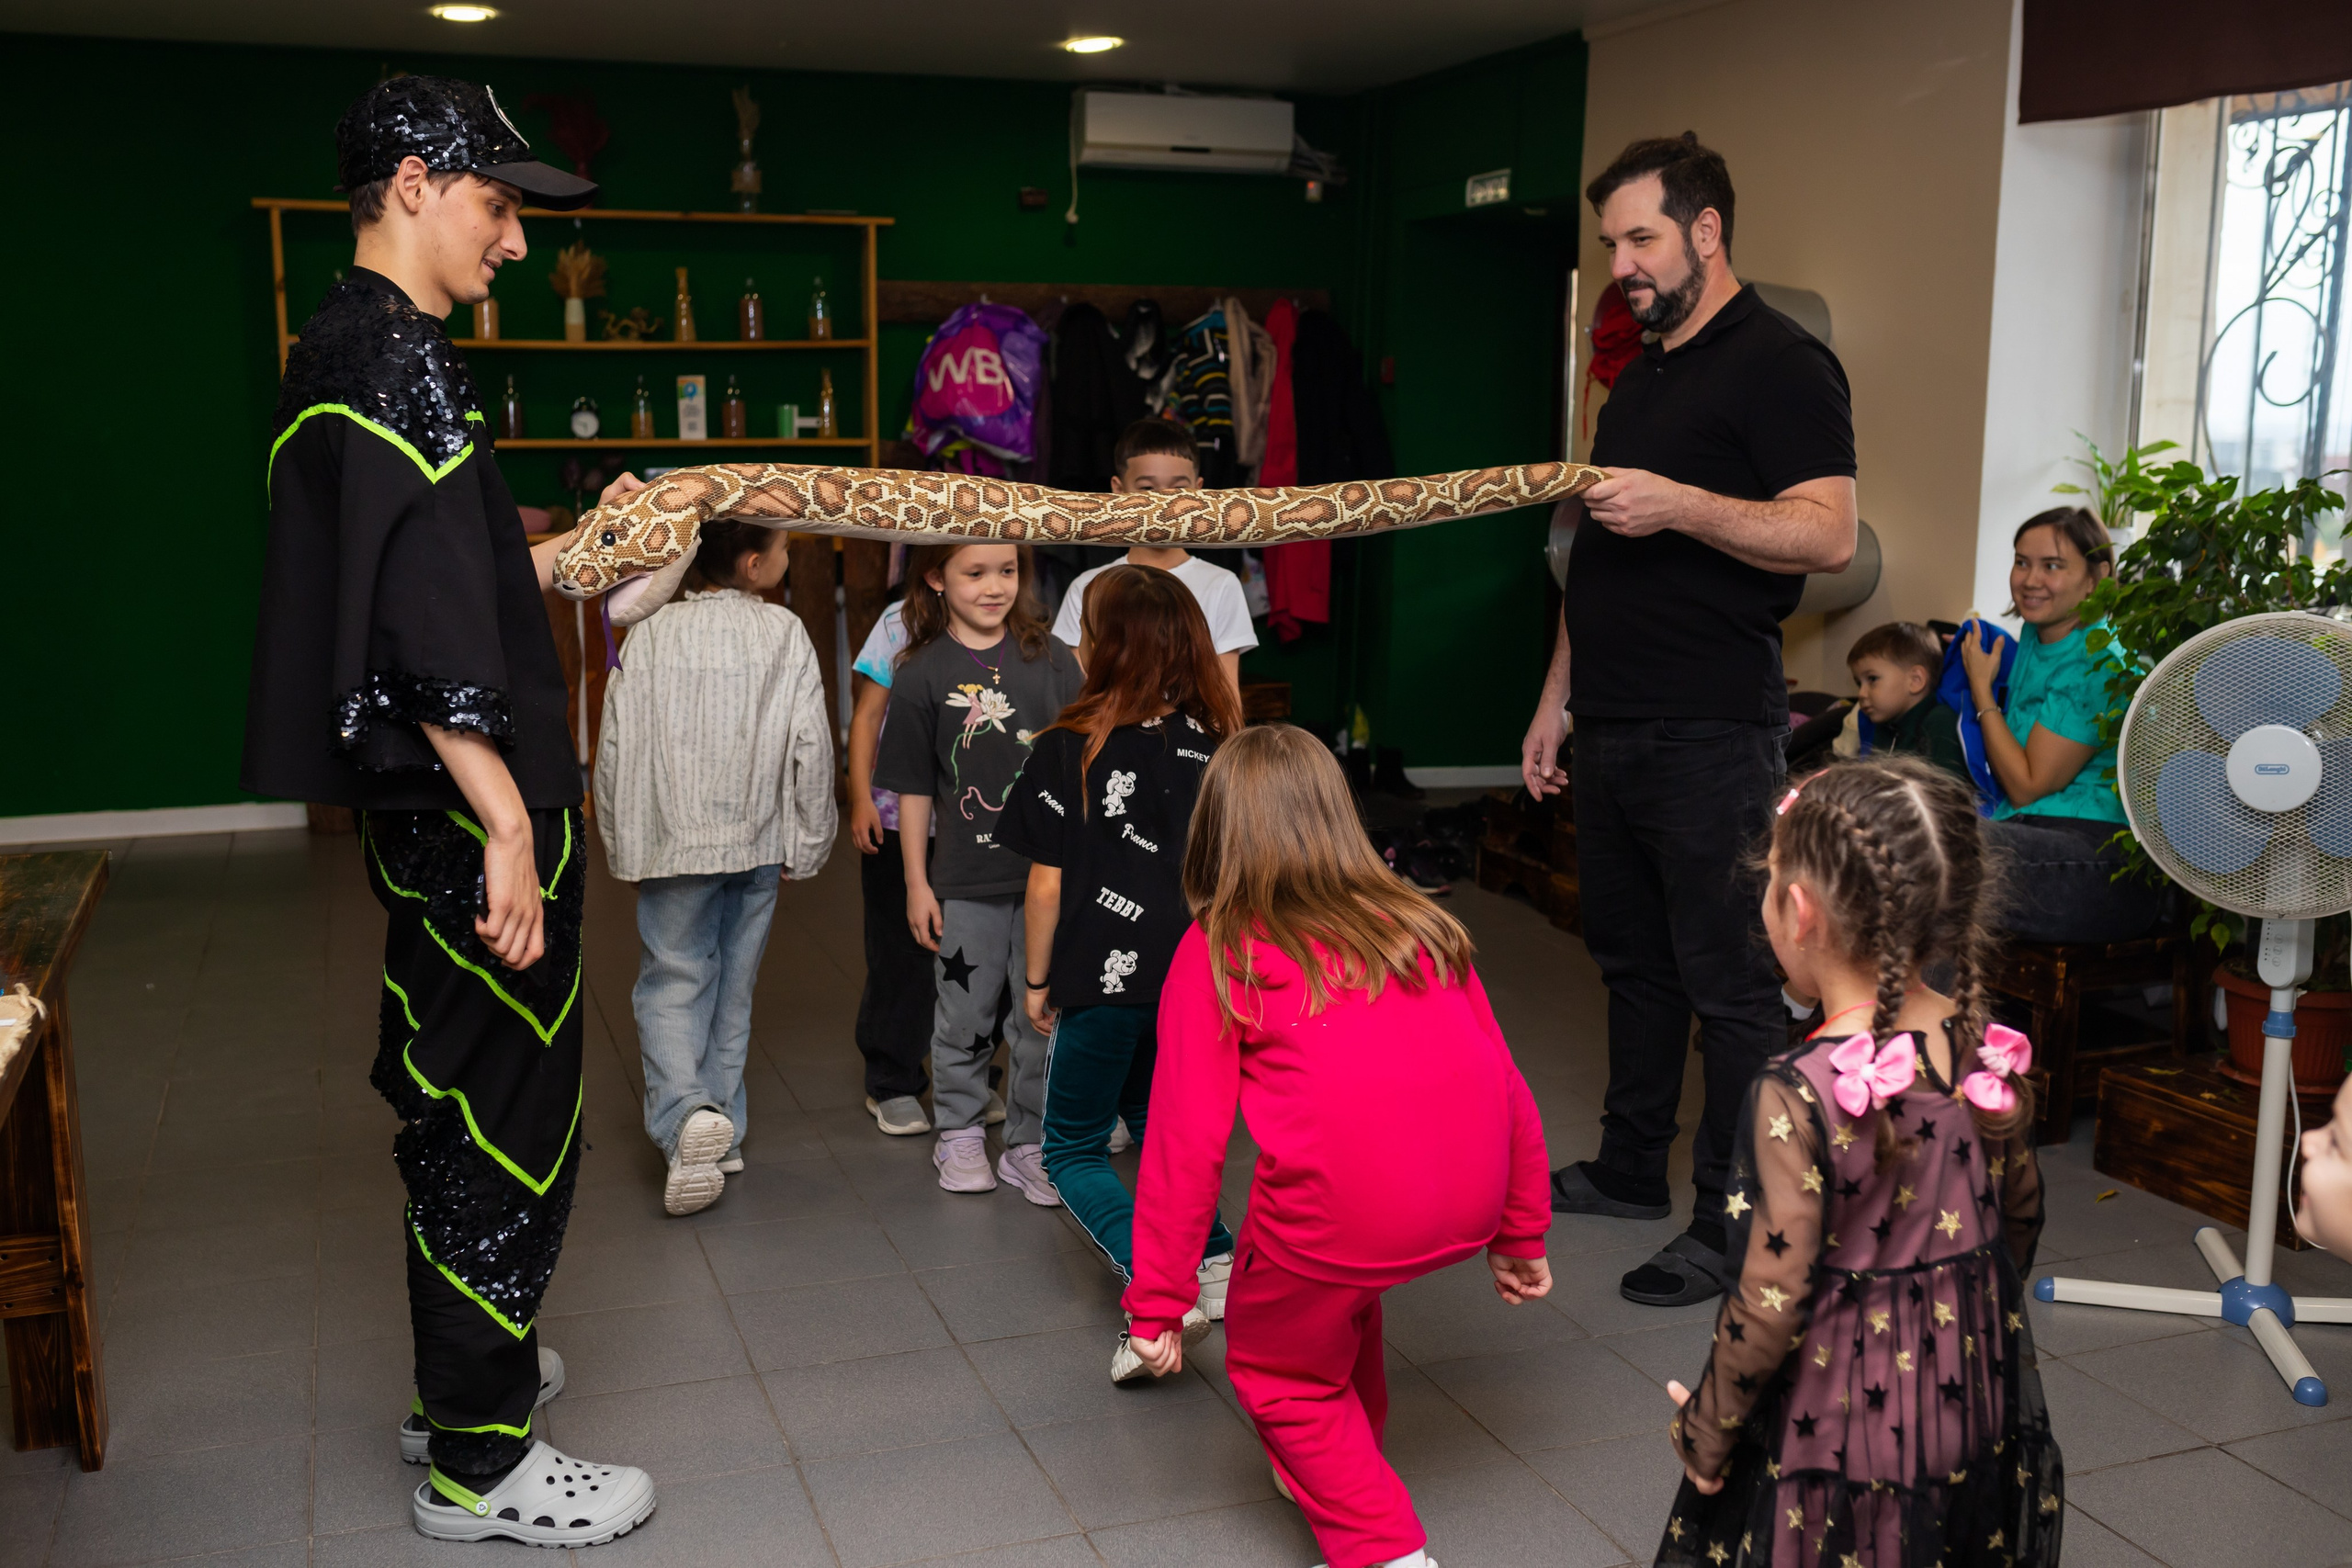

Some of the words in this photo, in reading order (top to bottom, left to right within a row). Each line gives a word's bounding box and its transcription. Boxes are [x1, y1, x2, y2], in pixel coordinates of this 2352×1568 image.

[928, 345, 1004, 392] WB
[1177, 748, 1210, 763] MICKEY
[1038, 789, 1065, 817] Fran
[1121, 823, 1159, 852] France
[1096, 886, 1145, 922] TEBBY
